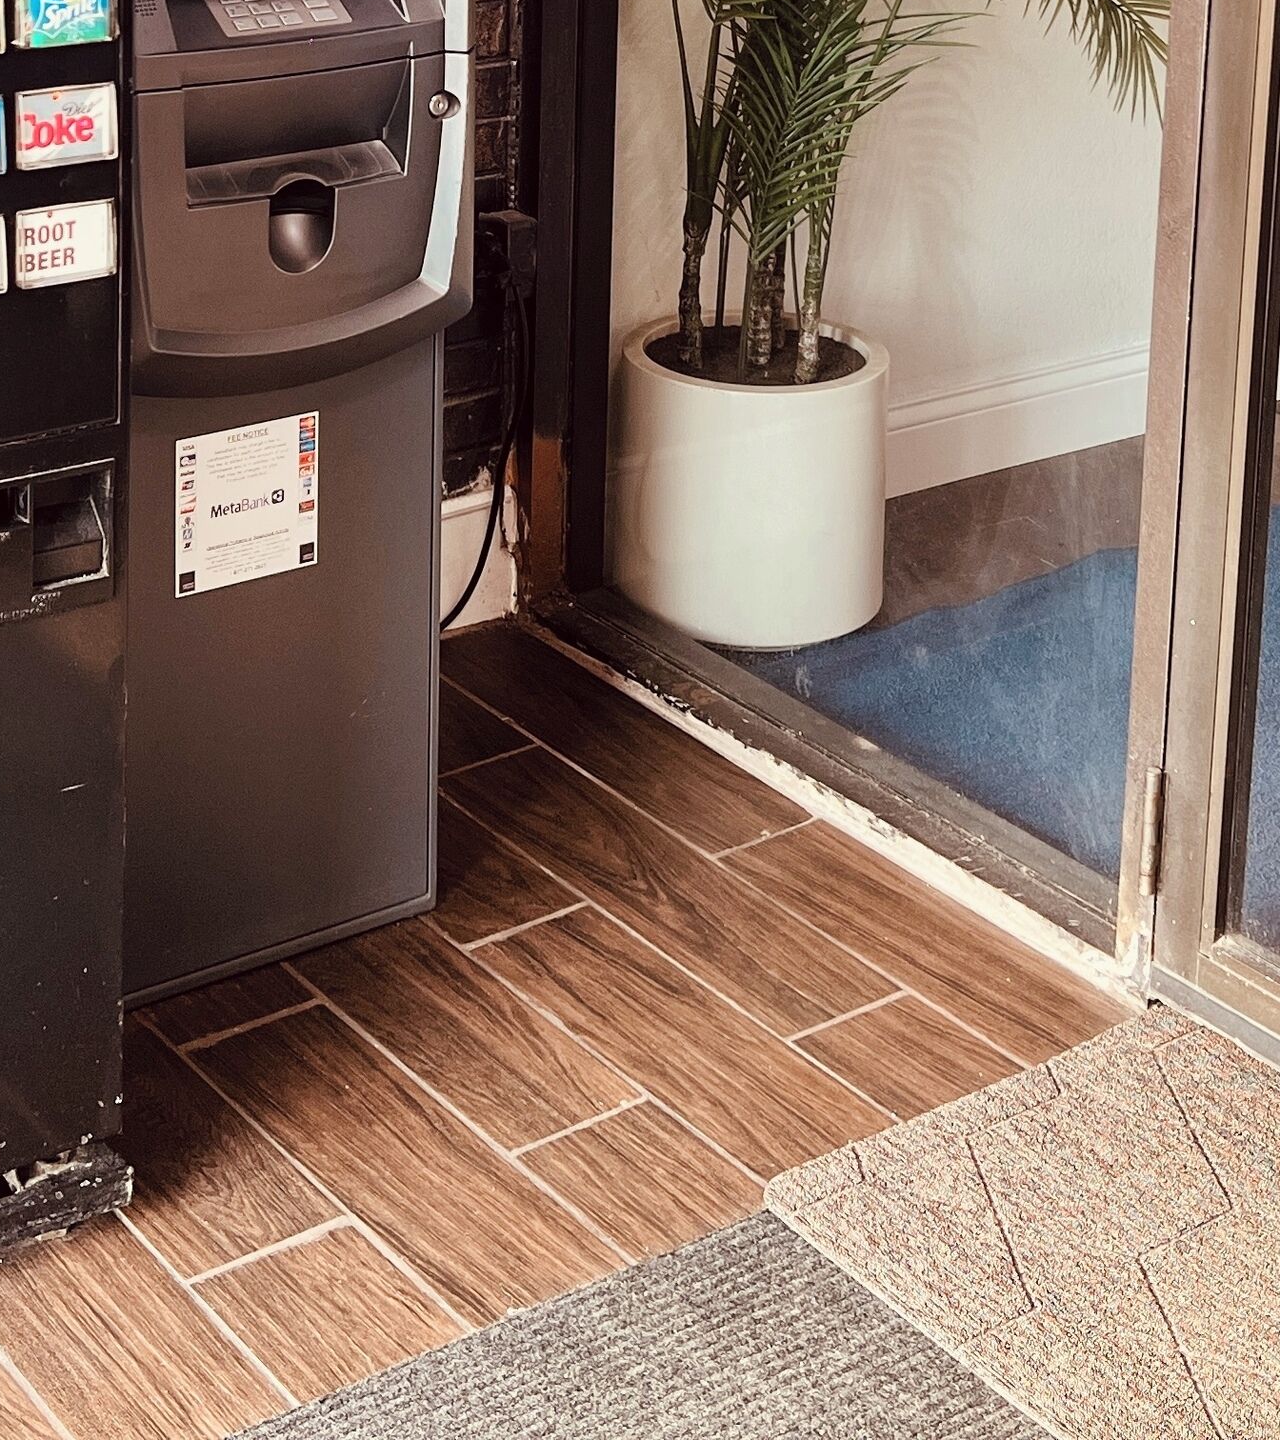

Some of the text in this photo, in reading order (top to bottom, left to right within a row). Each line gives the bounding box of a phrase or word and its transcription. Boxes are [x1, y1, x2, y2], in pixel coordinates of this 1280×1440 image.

[24, 220, 77, 247] ROOT
[24, 246, 76, 273] BEER
[210, 493, 271, 519] MetaBank
